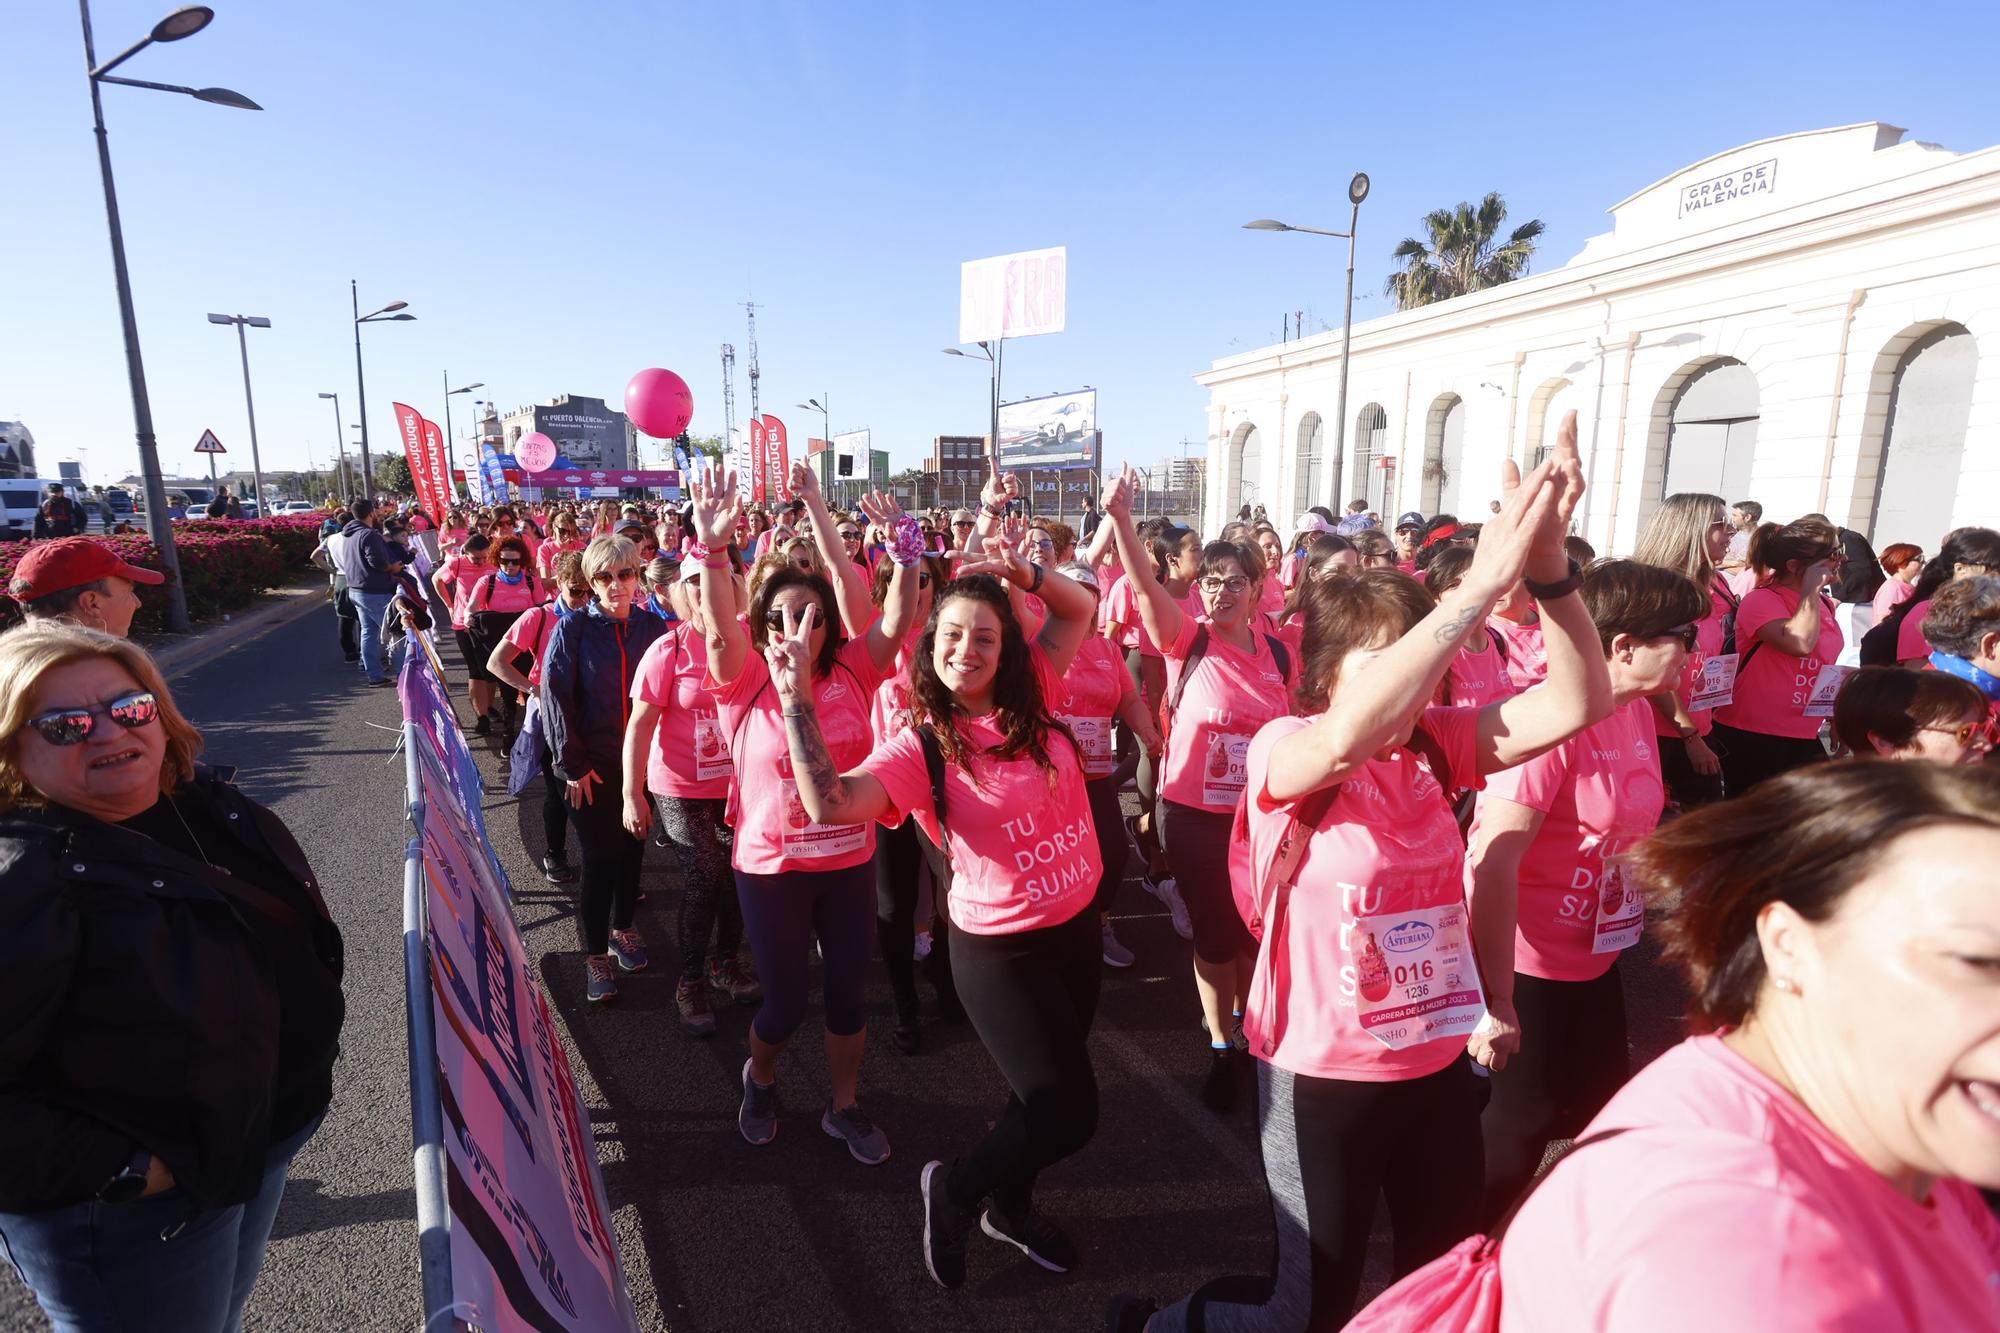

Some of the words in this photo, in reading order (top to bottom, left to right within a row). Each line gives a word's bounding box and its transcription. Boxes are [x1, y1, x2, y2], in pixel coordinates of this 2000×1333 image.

[1689, 178, 1734, 199] GRAO
[1743, 166, 1767, 184] DE
[1685, 179, 1767, 213] VALENCIA
[549, 414, 573, 422] PUERTO
[1800, 657, 1818, 671] TU
[1206, 706, 1232, 727] TU
[1230, 763, 1246, 775] 01
[794, 834, 819, 842] CARRERA
[1001, 812, 1035, 843] TU
[792, 845, 820, 854] OYSHO
[1025, 854, 1092, 902] SUMA
[1336, 882, 1383, 914] TU
[1559, 894, 1596, 920] SU
[1602, 935, 1626, 946] OYSHO
[1394, 959, 1434, 985] 016
[1404, 984, 1430, 1000] 1236
[1371, 1008, 1405, 1024] CARRERA
[1405, 1006, 1417, 1016] DE
[1416, 1004, 1426, 1013] LA
[1425, 999, 1447, 1011] MUJER
[1434, 1012, 1477, 1029] Santander
